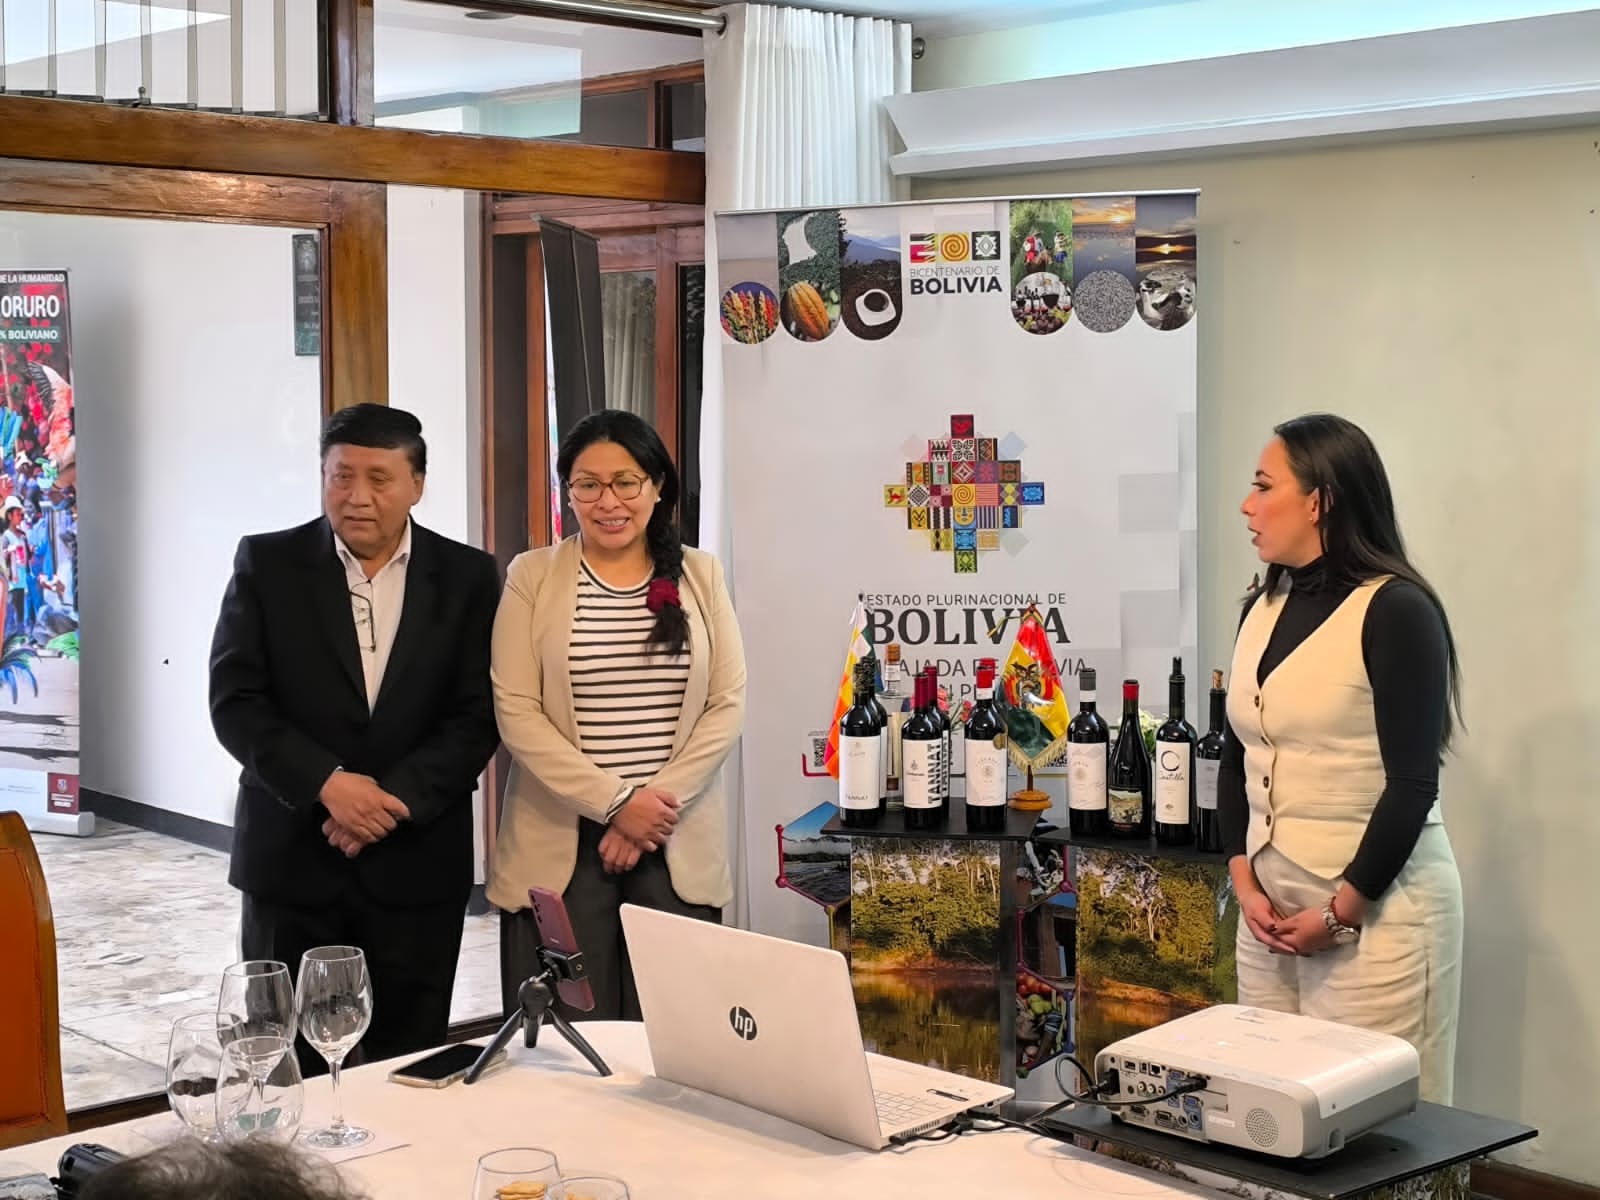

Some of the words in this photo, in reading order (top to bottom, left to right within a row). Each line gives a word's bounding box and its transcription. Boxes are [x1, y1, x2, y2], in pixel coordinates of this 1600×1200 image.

[18, 273, 65, 283] HUMANIDAD
[910, 266, 983, 278] BICENTENARIO
[986, 265, 1001, 275] DE
[910, 276, 1002, 295] BOLIVIA
[1, 295, 60, 318] ORURO
[8, 329, 58, 340] BOLIVIANO
[866, 594, 922, 606] ESTADO
[926, 593, 1042, 606] PLURINACIONAL
[1048, 592, 1067, 604] DE
[866, 607, 1072, 645] BOLIVA
[928, 743, 941, 804] TANNAT
[734, 1006, 753, 1040] hp
